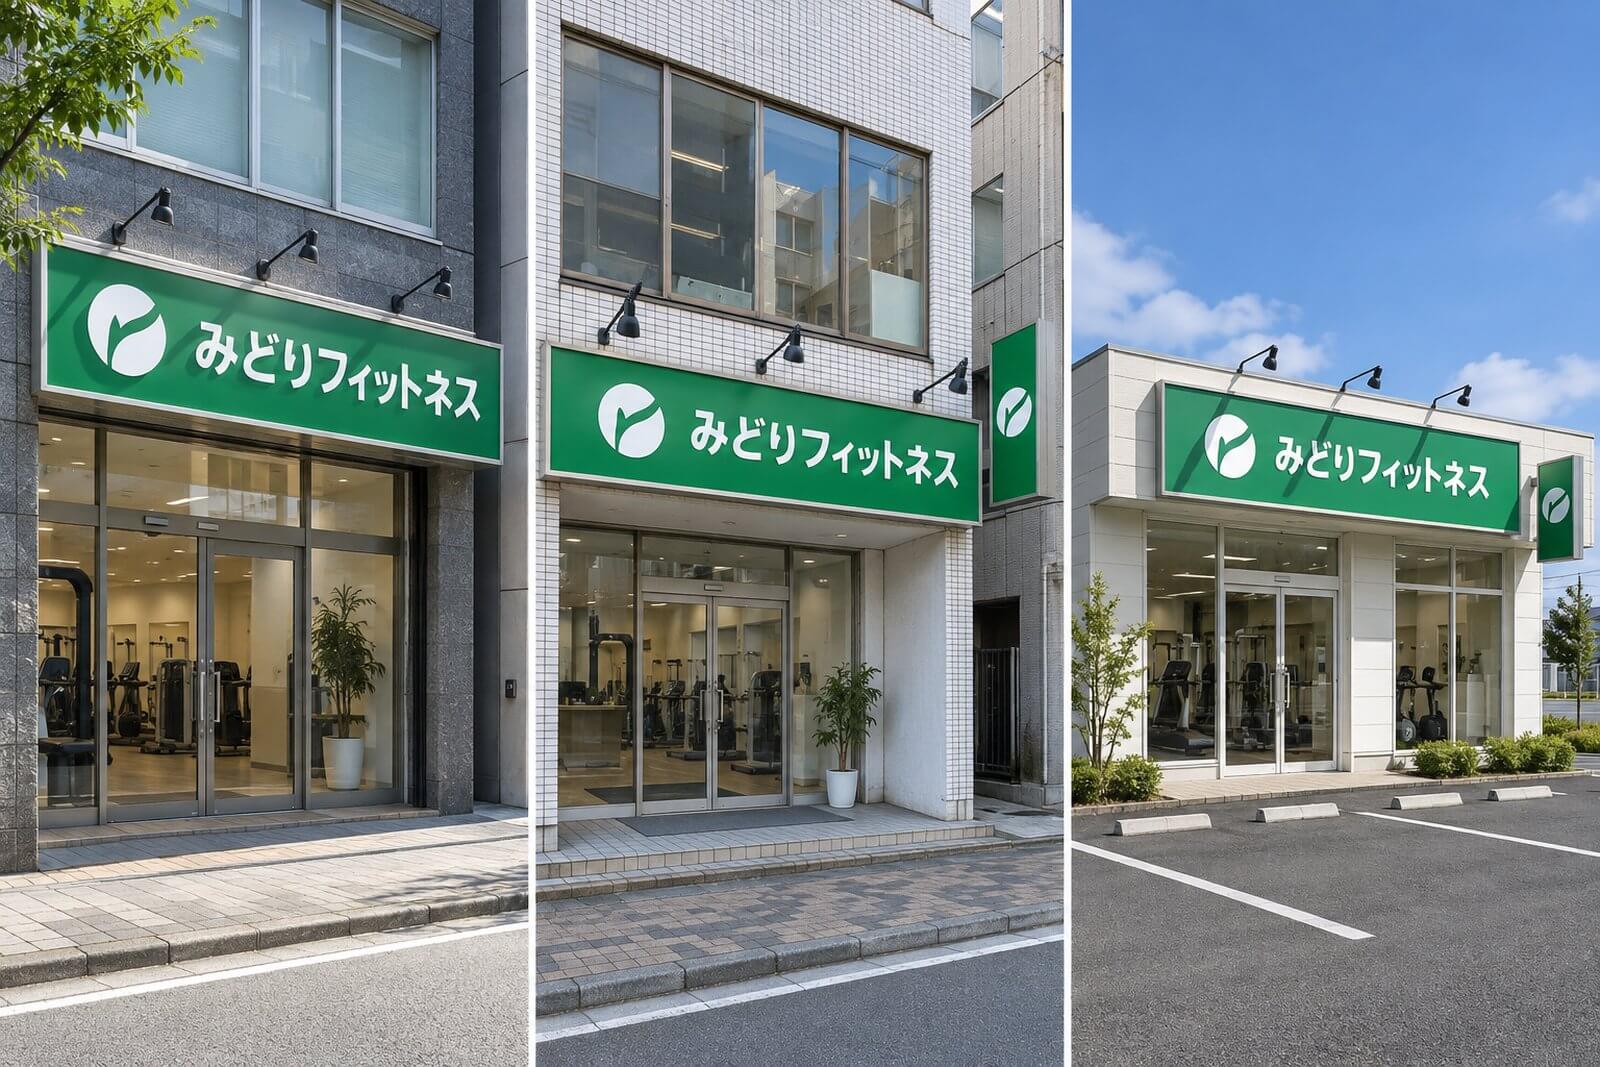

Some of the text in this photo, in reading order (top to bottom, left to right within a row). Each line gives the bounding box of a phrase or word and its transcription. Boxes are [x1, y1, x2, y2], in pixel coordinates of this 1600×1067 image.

[195, 321, 480, 421] みどりフィットネス
[691, 410, 959, 488] みどりフィットネス
[1275, 436, 1489, 499] みどりフィットネス
